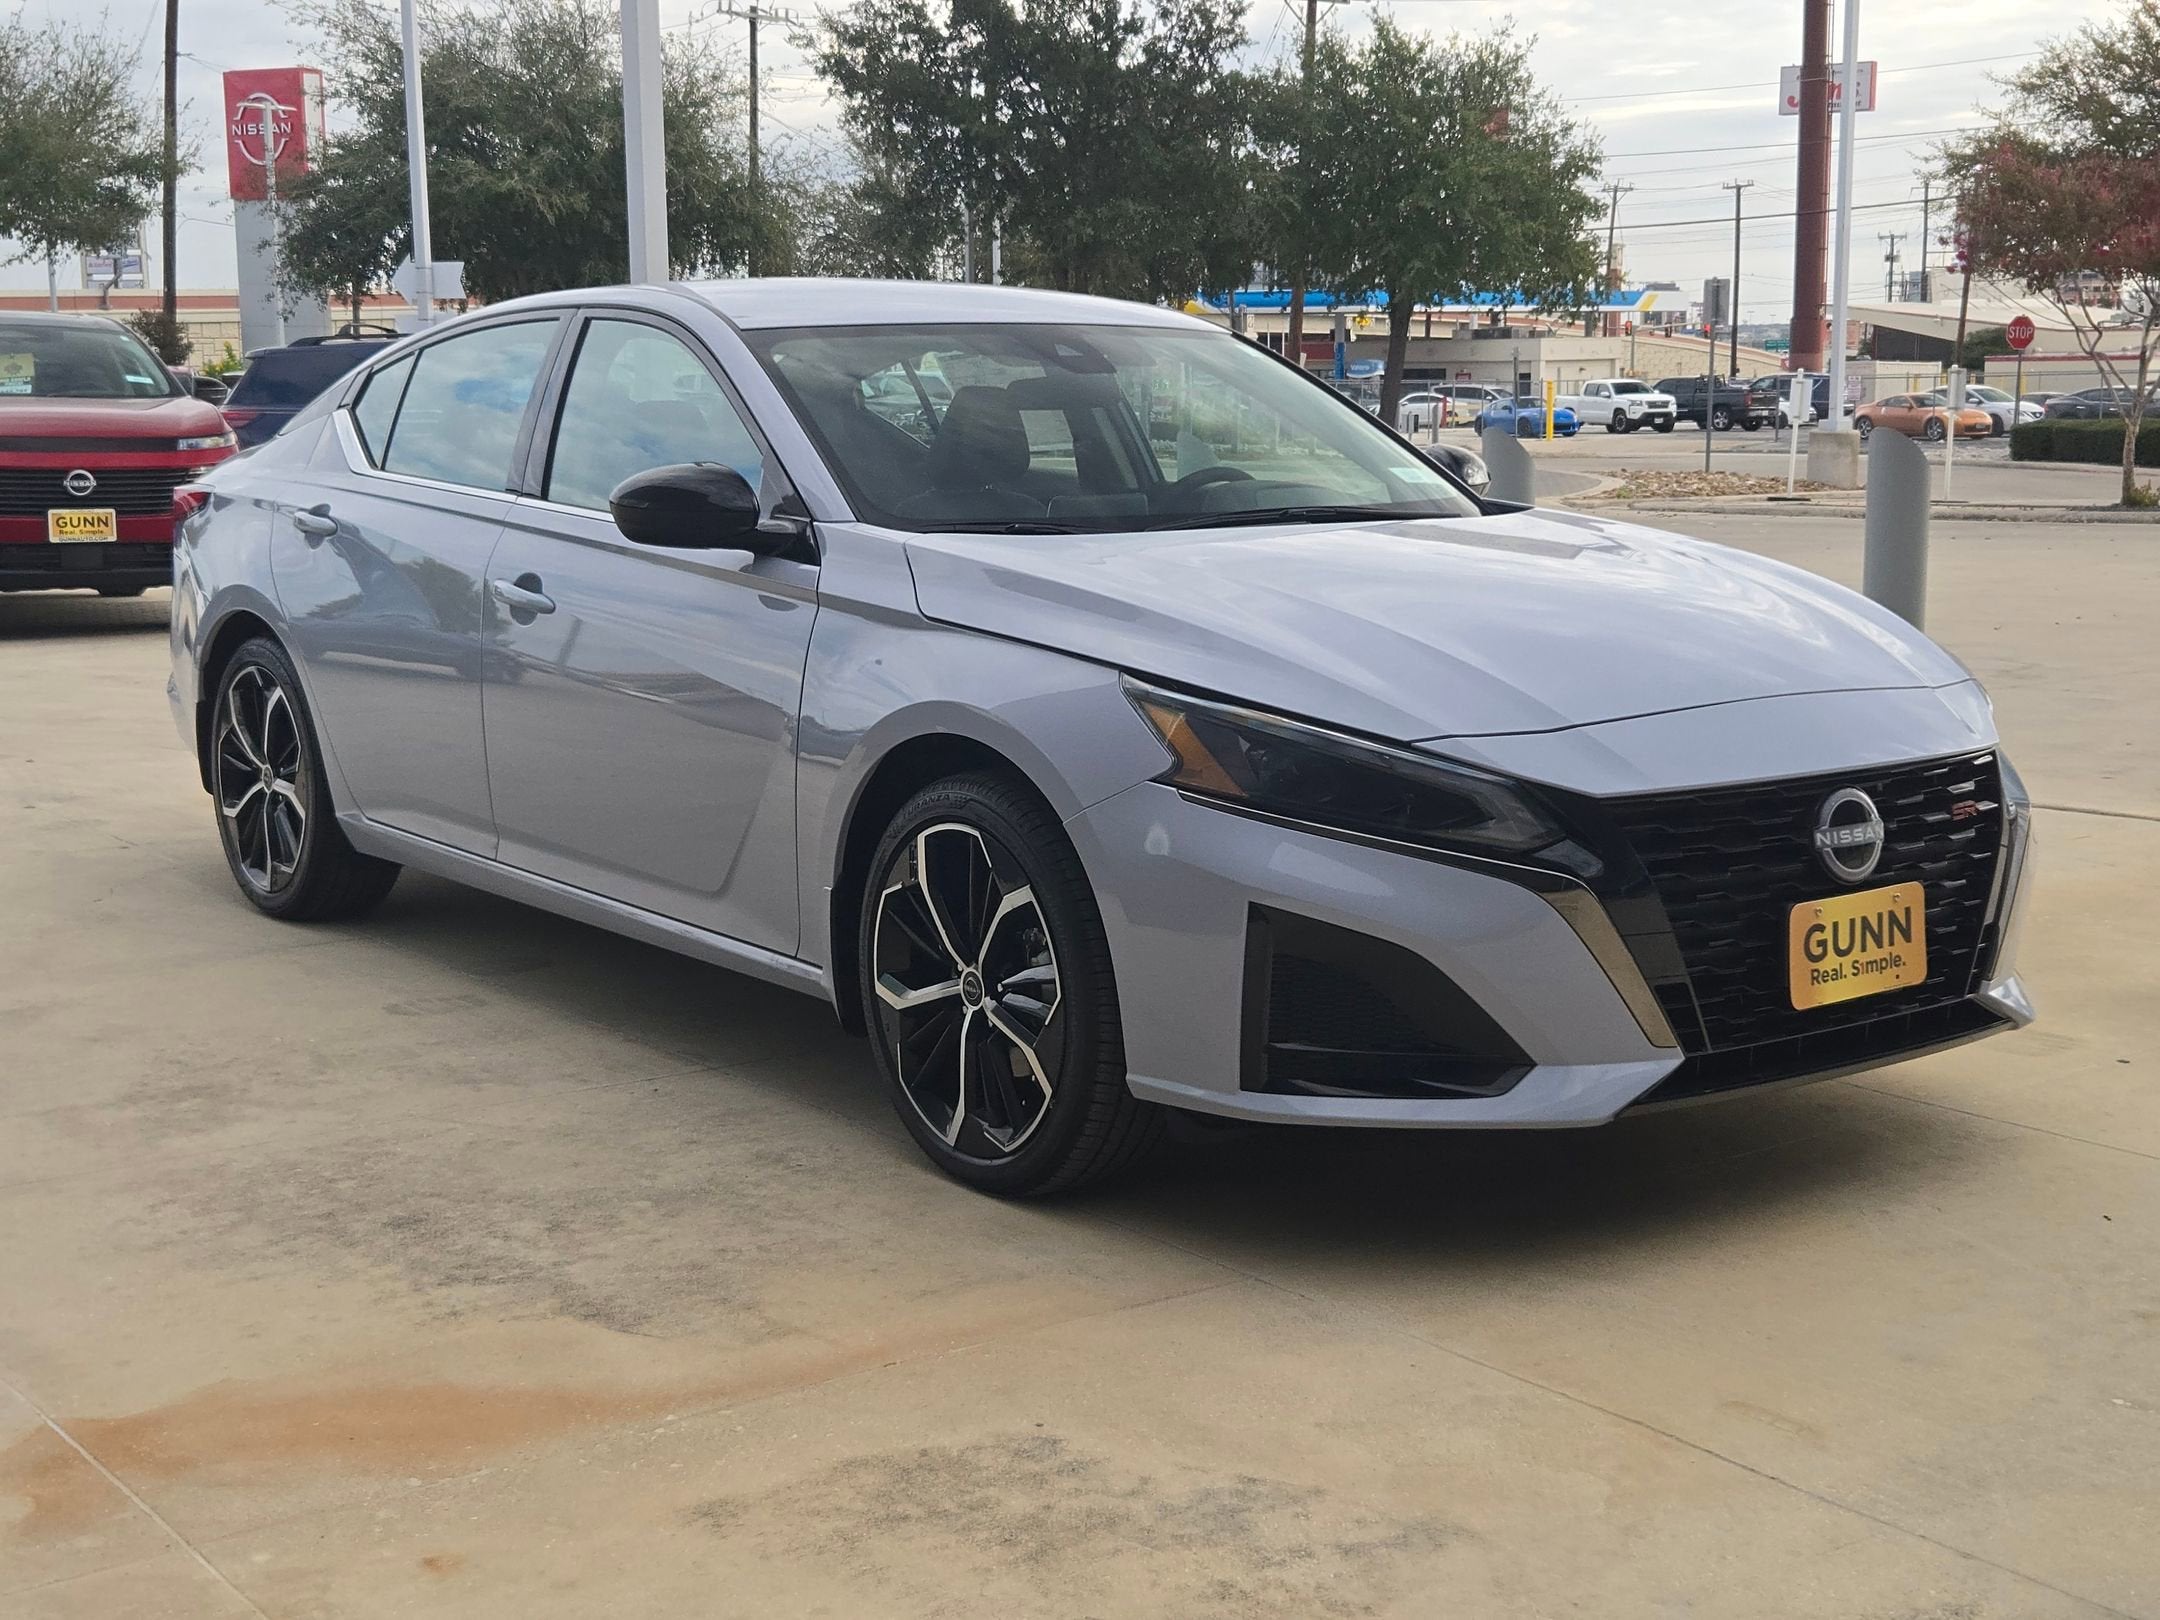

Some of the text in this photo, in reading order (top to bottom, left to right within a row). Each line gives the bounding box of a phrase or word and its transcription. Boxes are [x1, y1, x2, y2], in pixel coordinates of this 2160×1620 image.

[232, 122, 291, 136] NISSAN
[2008, 326, 2034, 339] STOP
[56, 516, 109, 528] GUNN
[1951, 800, 1977, 821] SR
[1803, 906, 1912, 963] GUNN
[1811, 963, 1847, 986] Real.
